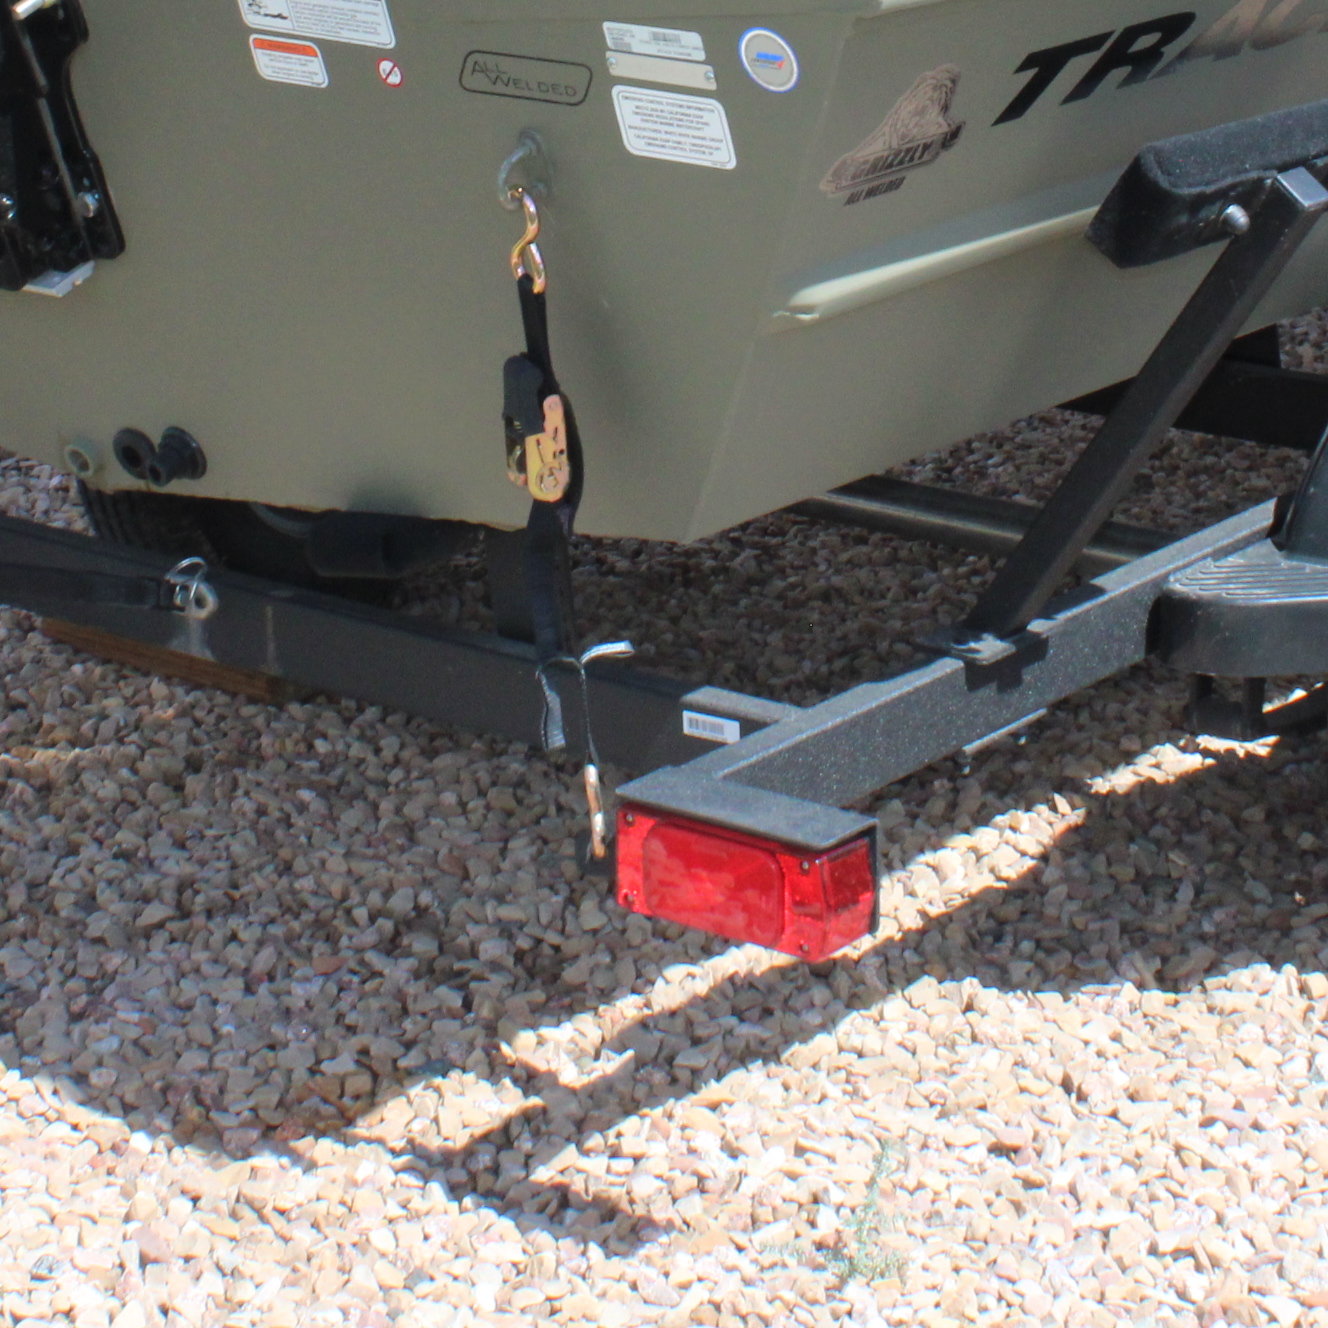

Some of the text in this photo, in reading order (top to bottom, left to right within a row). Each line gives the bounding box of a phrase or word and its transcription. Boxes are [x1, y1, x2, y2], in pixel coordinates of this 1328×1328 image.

[471, 60, 508, 76] ALL
[483, 71, 577, 97] WELDED
[830, 140, 934, 183] GRIZZLY
